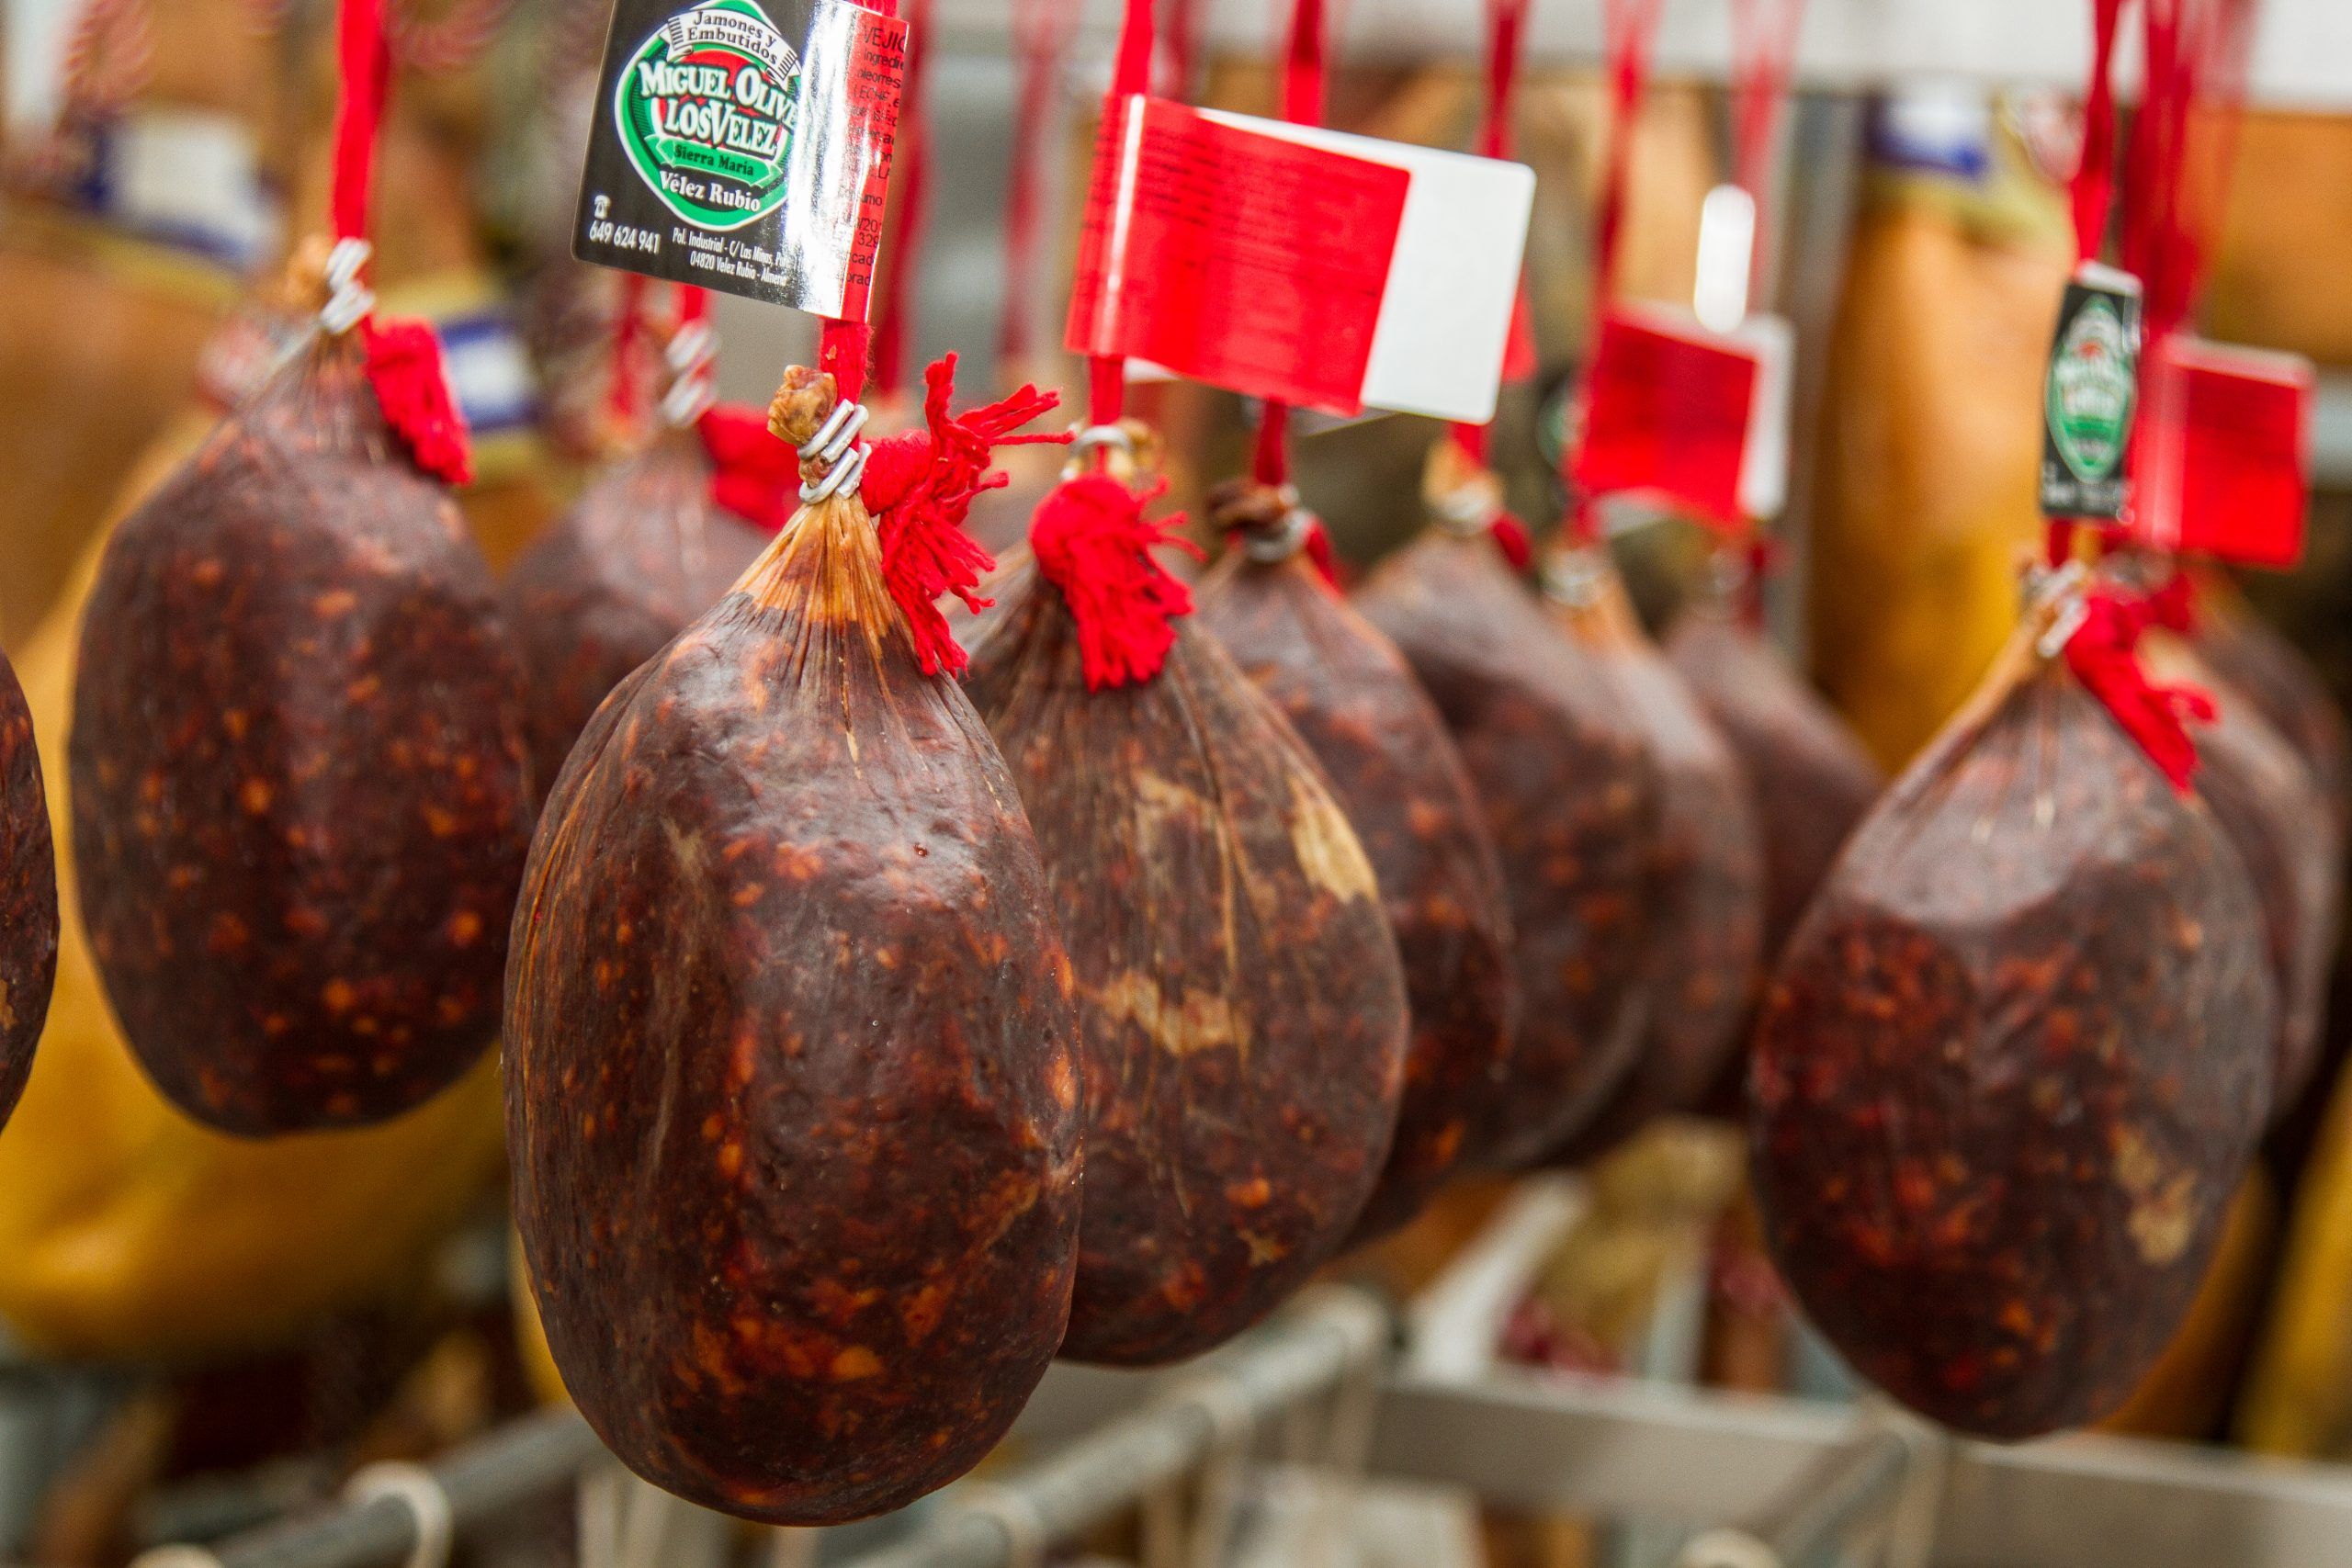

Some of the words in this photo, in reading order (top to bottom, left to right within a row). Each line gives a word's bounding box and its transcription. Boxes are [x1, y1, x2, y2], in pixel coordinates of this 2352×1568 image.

[687, 27, 777, 65] Embutidos
[694, 11, 763, 39] Jamones
[765, 35, 776, 48] y
[638, 59, 732, 100] MIGUEL
[674, 144, 714, 166] Sierra
[660, 170, 706, 199] Vélez
[709, 182, 761, 212] Rubio
[589, 220, 615, 244] 649
[614, 225, 639, 250] 624
[639, 230, 662, 254] 941
[673, 227, 687, 245] Pol.
[688, 231, 725, 254] Industrial
[690, 250, 717, 271] 04820
[735, 260, 756, 279] Rubio
